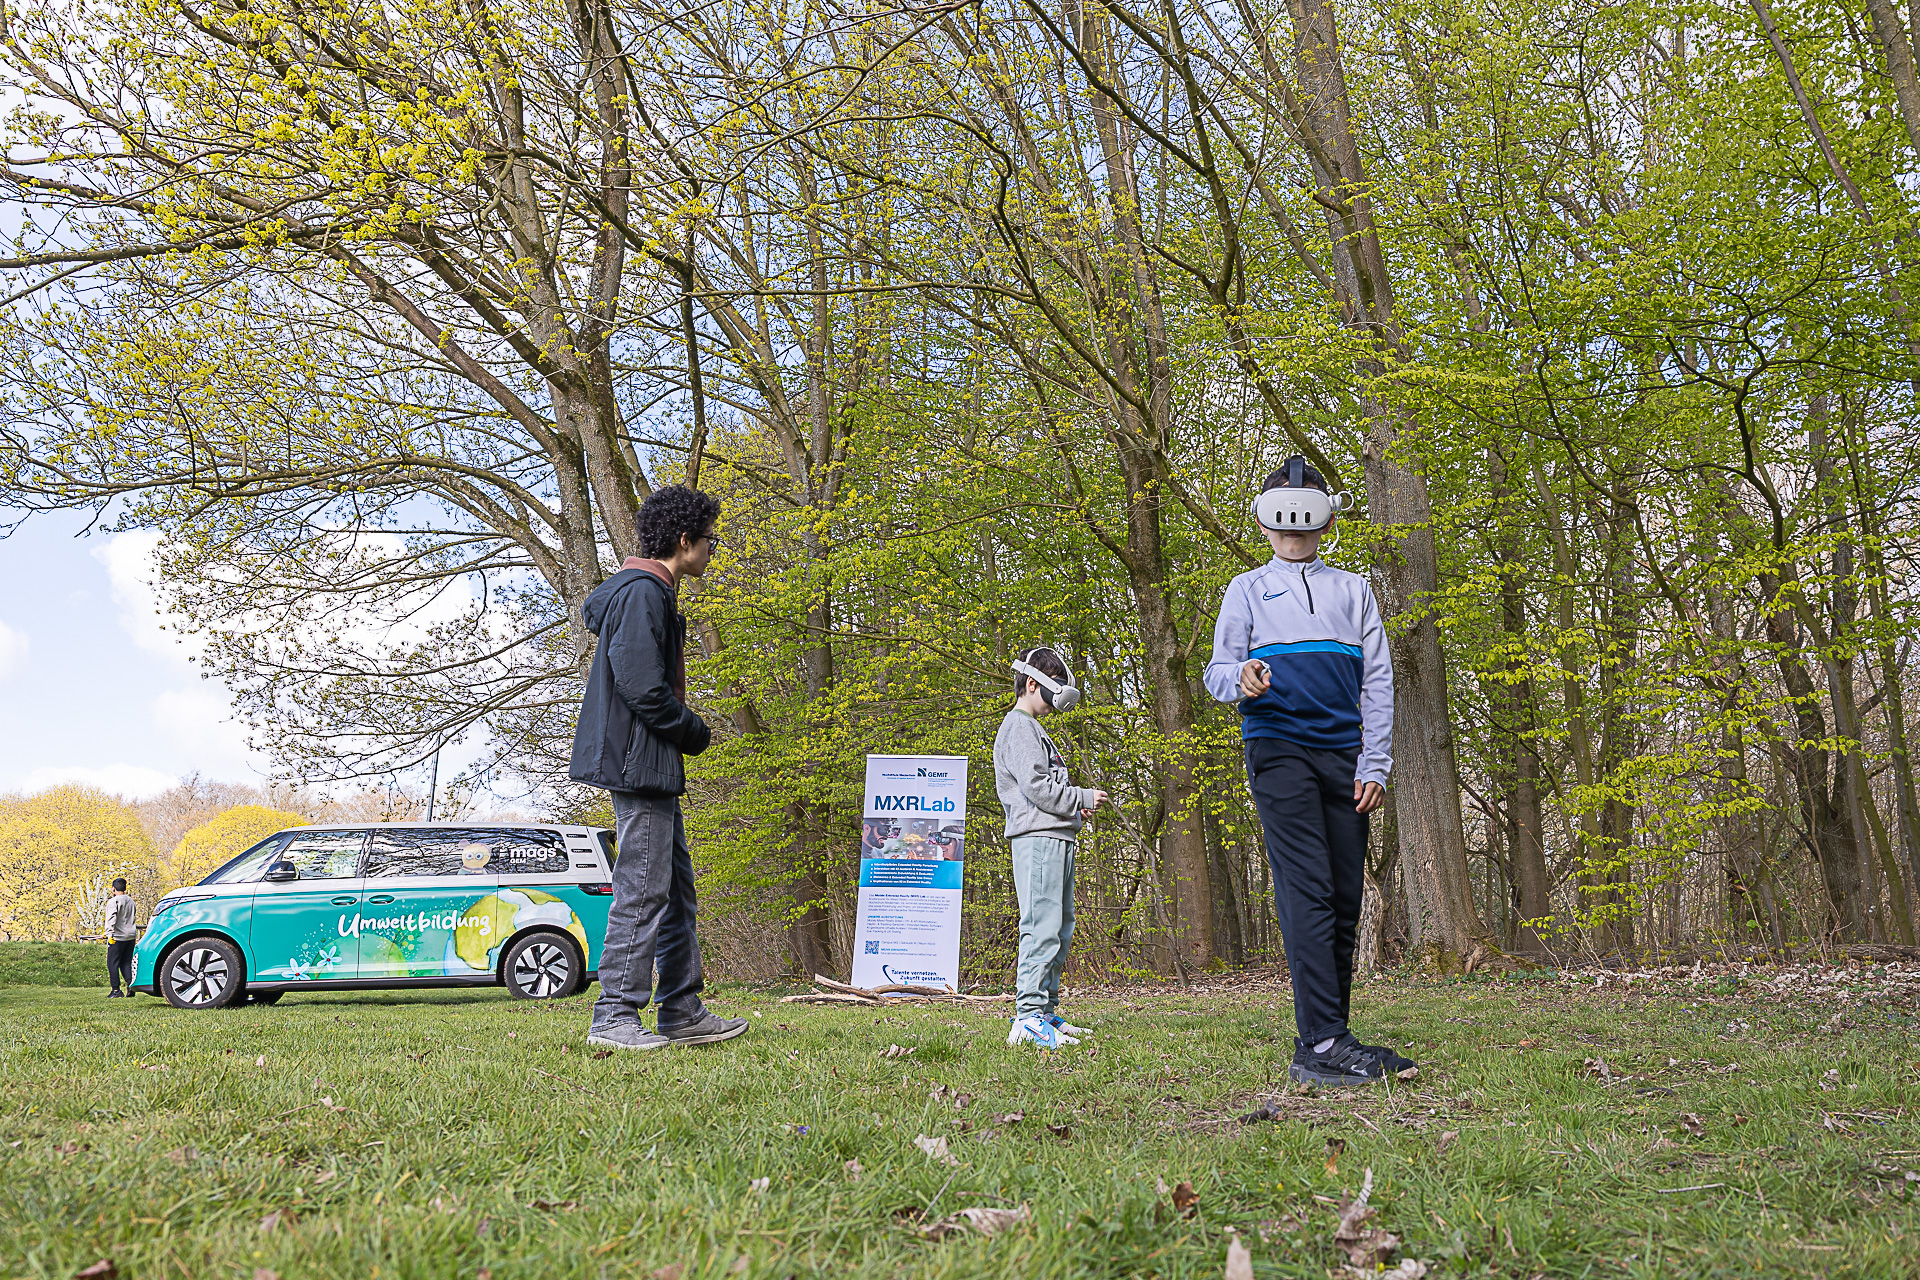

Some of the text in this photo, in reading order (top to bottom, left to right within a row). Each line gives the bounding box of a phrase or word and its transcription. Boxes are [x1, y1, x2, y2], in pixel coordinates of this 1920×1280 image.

[874, 795, 955, 812] MXRLab
[509, 847, 557, 862] mags
[337, 909, 492, 938] Umweltbildung
